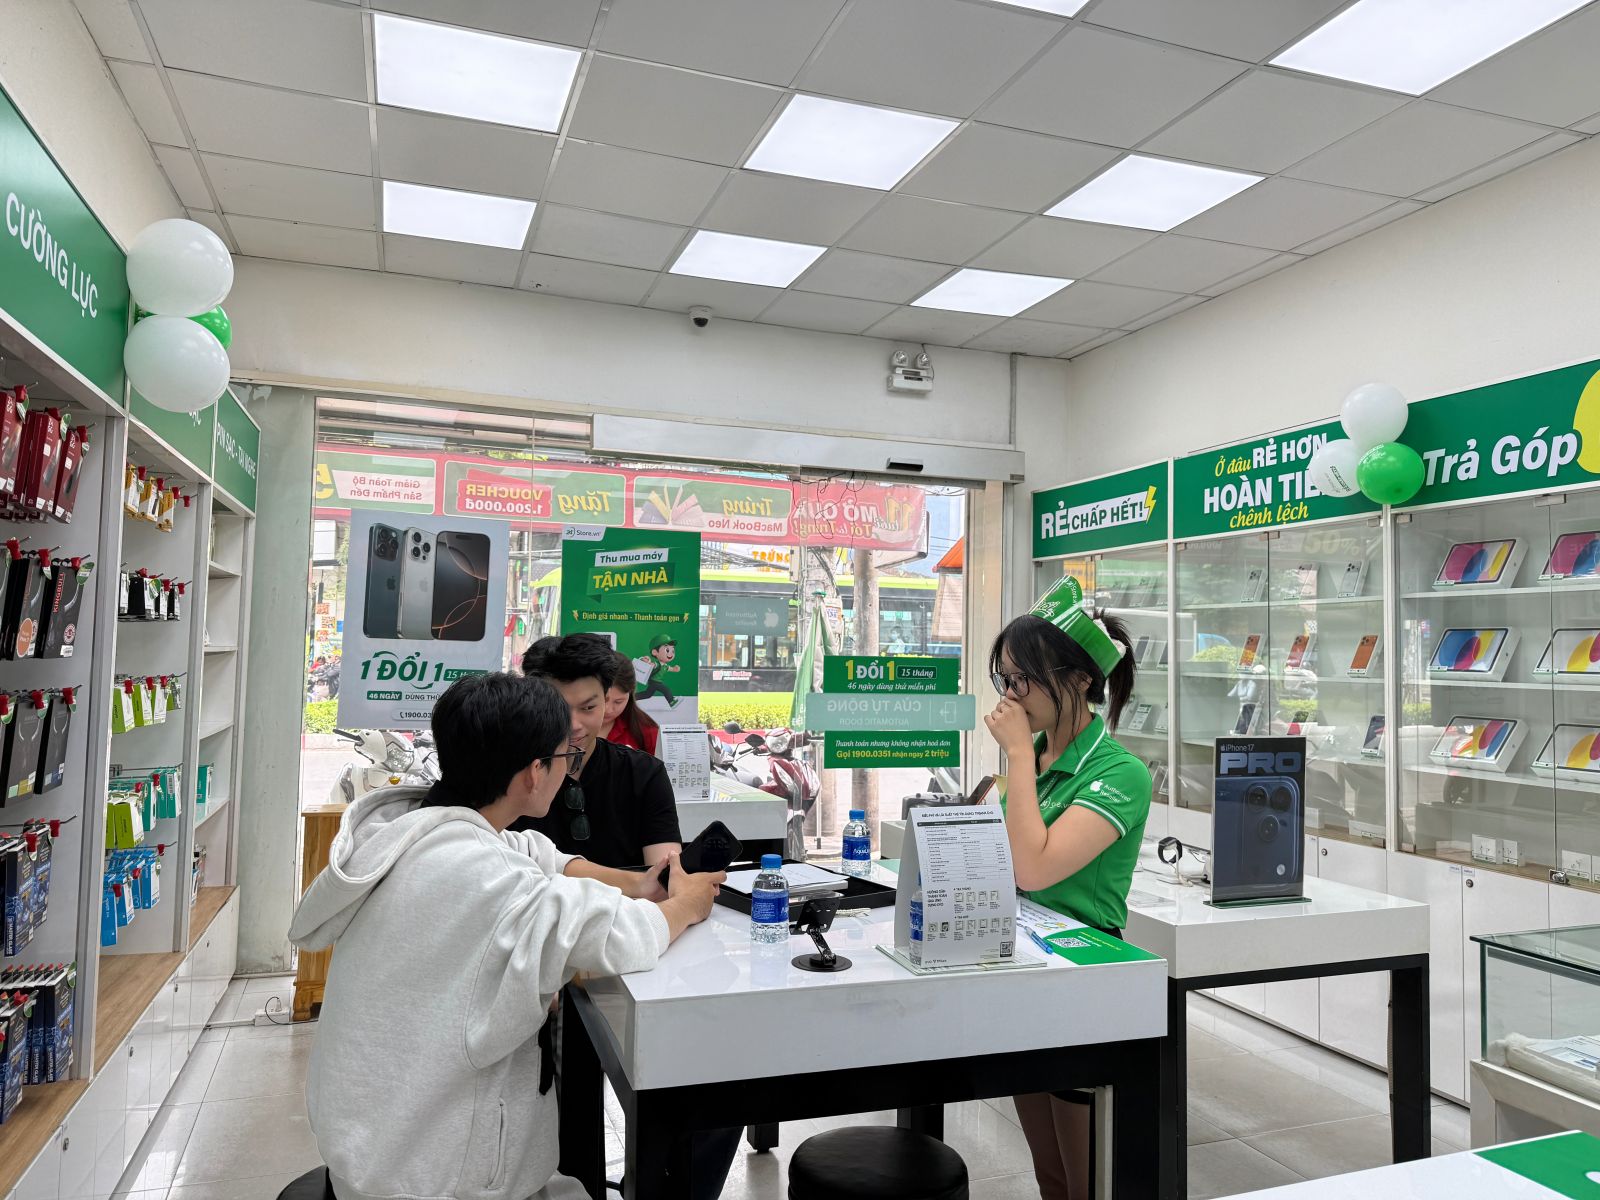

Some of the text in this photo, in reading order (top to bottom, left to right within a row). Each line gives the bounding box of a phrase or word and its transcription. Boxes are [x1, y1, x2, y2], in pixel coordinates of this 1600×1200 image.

[6, 192, 99, 319] CƯỜNG LỰC
[1215, 455, 1226, 478] Ở
[1226, 457, 1251, 475] đâu
[1252, 438, 1278, 469] RẺ
[1422, 425, 1578, 487] Trả Góp
[1203, 474, 1273, 515] HOÀN
[1041, 498, 1143, 539] RẺ CHẤP HẾT!
[1229, 502, 1309, 529] chênh lệch
[600, 551, 663, 563] Thu mua máy
[593, 567, 668, 591] TẬN NHÀ
[582, 612, 597, 622] Định
[598, 612, 608, 622] giá
[609, 612, 629, 621] nhanh
[634, 612, 653, 622] Thanh
[653, 613, 668, 622] toán
[360, 652, 458, 682] 1 ĐỔI 1 15
[845, 659, 934, 681] 1 ĐỔI 1 15 tháng
[379, 691, 401, 700] NGÀY
[405, 692, 425, 700] DÙNG
[847, 682, 857, 690] 46
[858, 683, 875, 692] ngày
[876, 682, 894, 691] dùng
[924, 683, 937, 692] phí
[835, 740, 854, 748] Thanh
[855, 740, 869, 748] toán
[890, 740, 909, 748] không
[836, 750, 850, 760] Gọi
[852, 750, 891, 758] 1900.0351
[931, 749, 950, 759] triệu
[1225, 743, 1254, 752] iPhone 17
[1219, 752, 1302, 775] PRO
